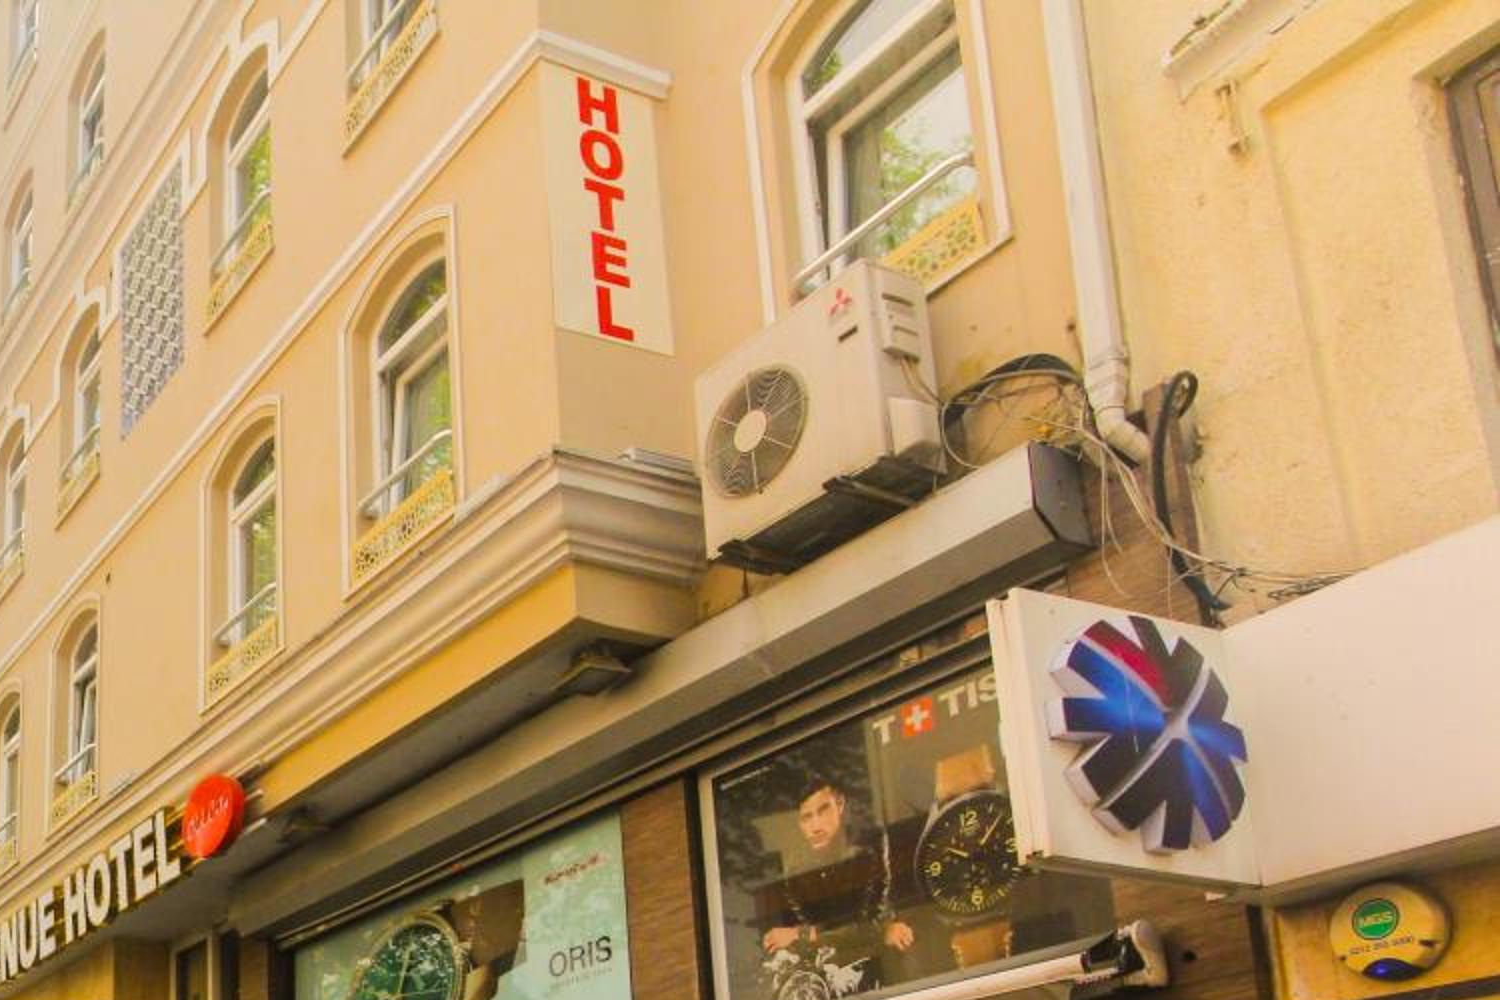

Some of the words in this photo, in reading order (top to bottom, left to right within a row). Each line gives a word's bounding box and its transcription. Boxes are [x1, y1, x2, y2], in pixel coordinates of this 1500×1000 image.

[577, 76, 634, 342] HOTEL
[63, 809, 181, 944] HOTEL
[548, 935, 613, 977] ORIS
